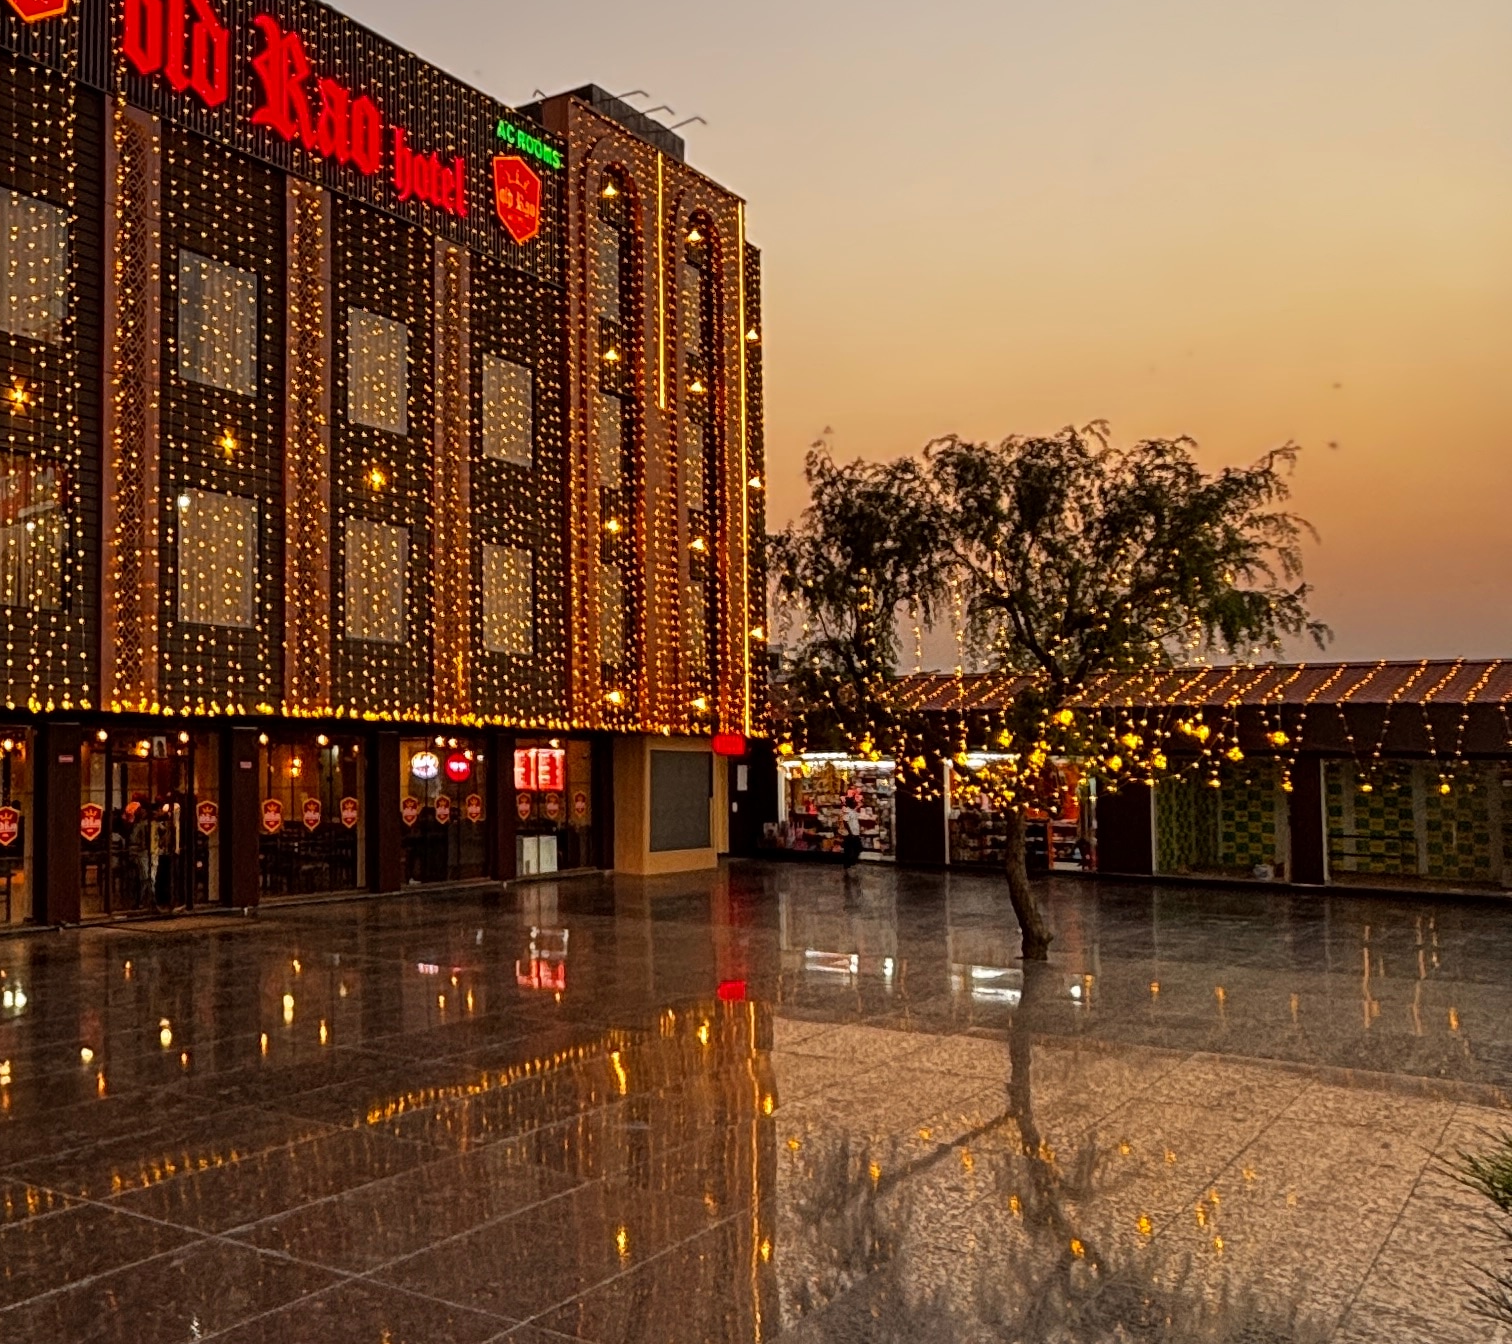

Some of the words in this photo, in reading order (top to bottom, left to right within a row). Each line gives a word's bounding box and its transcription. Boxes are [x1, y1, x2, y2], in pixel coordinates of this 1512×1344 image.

[251, 13, 382, 175] Rao
[392, 125, 469, 218] hotel
[496, 119, 515, 144] AC
[517, 129, 562, 169] ROOMS
